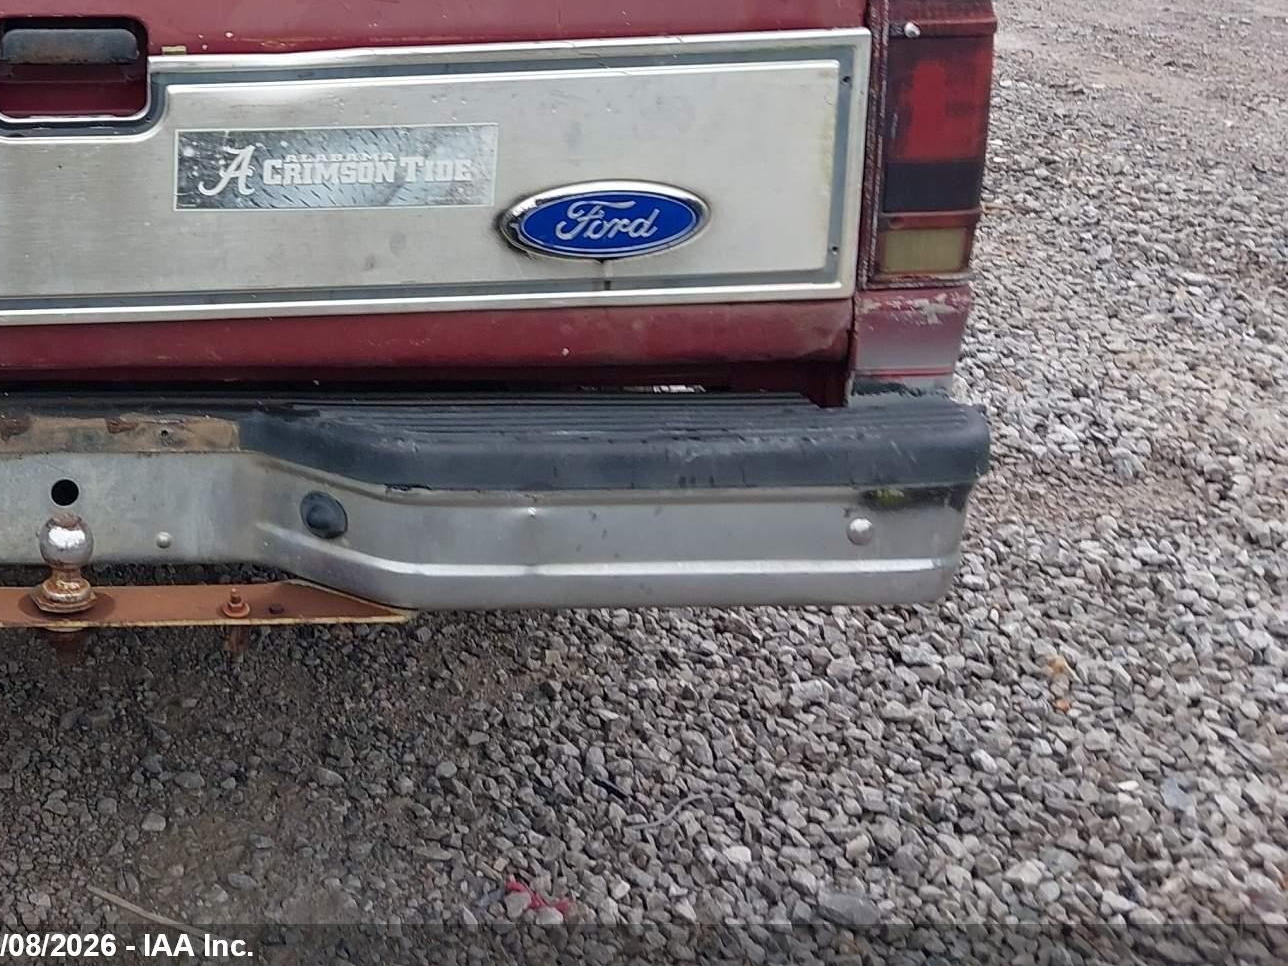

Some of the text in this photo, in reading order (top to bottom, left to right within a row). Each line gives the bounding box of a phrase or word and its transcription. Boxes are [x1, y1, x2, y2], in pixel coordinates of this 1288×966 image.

[263, 156, 474, 186] CRIMSON TIDE
[284, 153, 396, 164] ALABAMA
[555, 200, 660, 241] Ford
